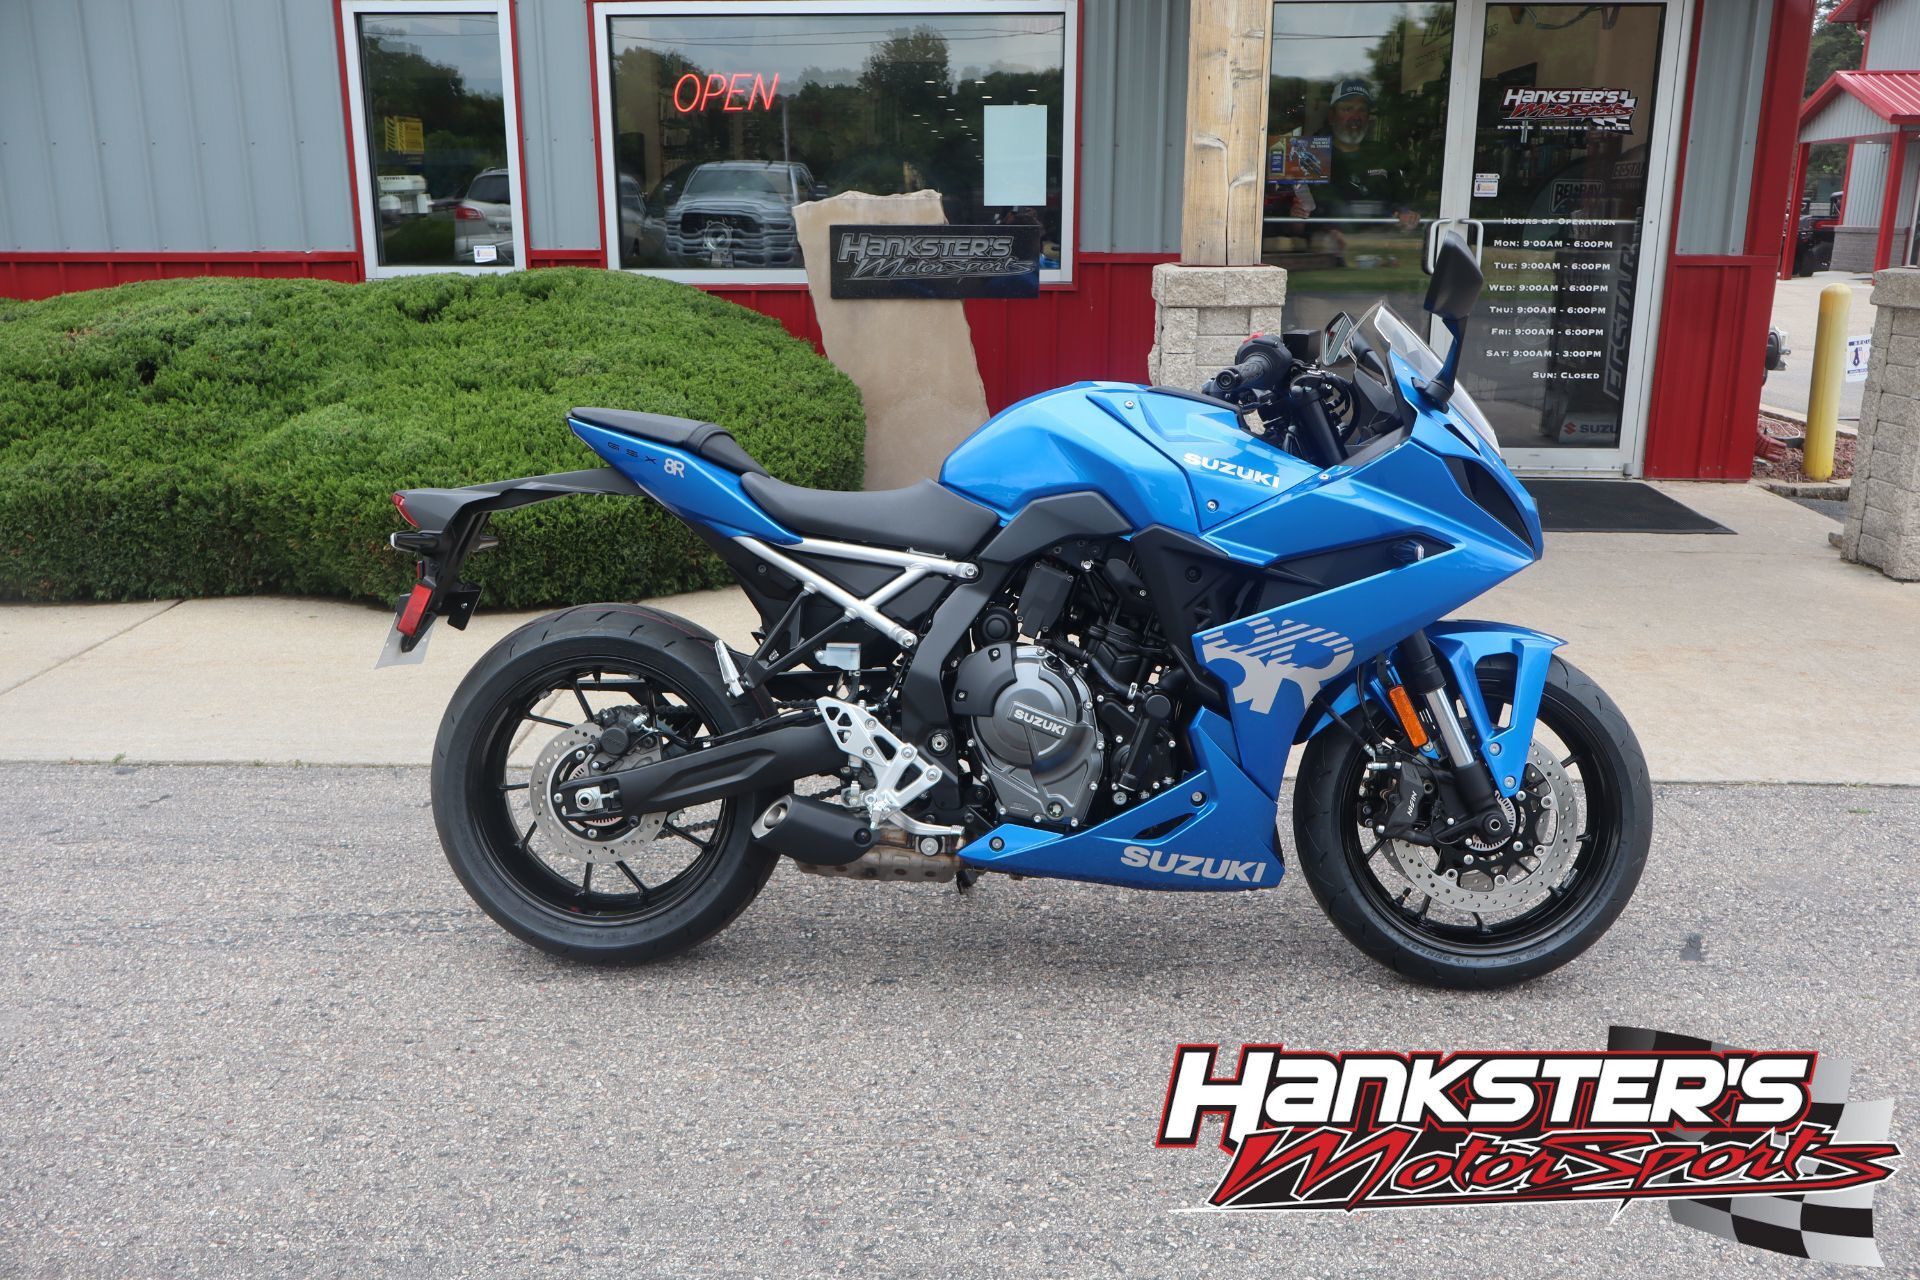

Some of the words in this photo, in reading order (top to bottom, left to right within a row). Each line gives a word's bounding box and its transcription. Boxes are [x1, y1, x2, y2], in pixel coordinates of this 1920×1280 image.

[674, 73, 780, 112] OPEN
[1573, 240, 1614, 249] 6:00PM
[1521, 262, 1561, 271] 9:00AM
[1571, 262, 1611, 271] 6:00PM
[1519, 284, 1559, 293] 9:00AM
[1569, 284, 1609, 293] 6:00PM
[1517, 306, 1557, 315] 9:00AM
[1567, 306, 1607, 315] 6:00PM
[1515, 328, 1555, 336] 9:00AM
[1565, 328, 1604, 336] 6:00PM
[1513, 350, 1553, 358] 9:00AM
[1562, 350, 1602, 358] 3:00PM
[664, 458, 685, 479] 8R
[1183, 452, 1280, 489] SUZUKI
[1013, 709, 1068, 736] SUZUKI
[1120, 845, 1267, 883] SUZUKI
